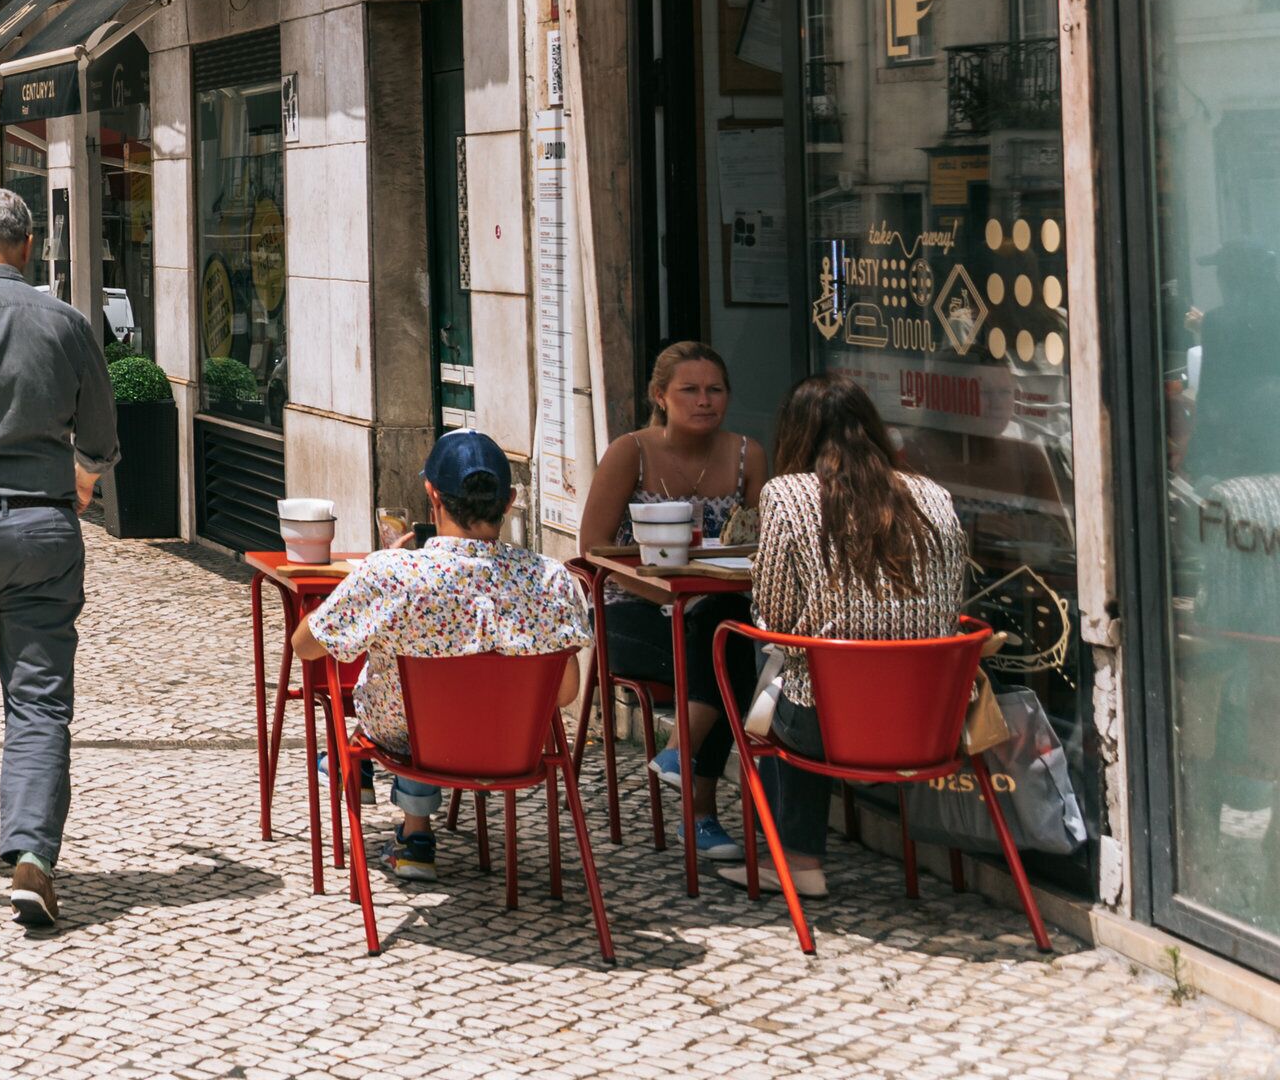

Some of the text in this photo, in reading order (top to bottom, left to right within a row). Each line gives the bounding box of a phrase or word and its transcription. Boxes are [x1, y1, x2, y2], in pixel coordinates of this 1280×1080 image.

[22, 81, 48, 101] CENTURY
[868, 220, 892, 245] take
[843, 257, 880, 286] TASTY
